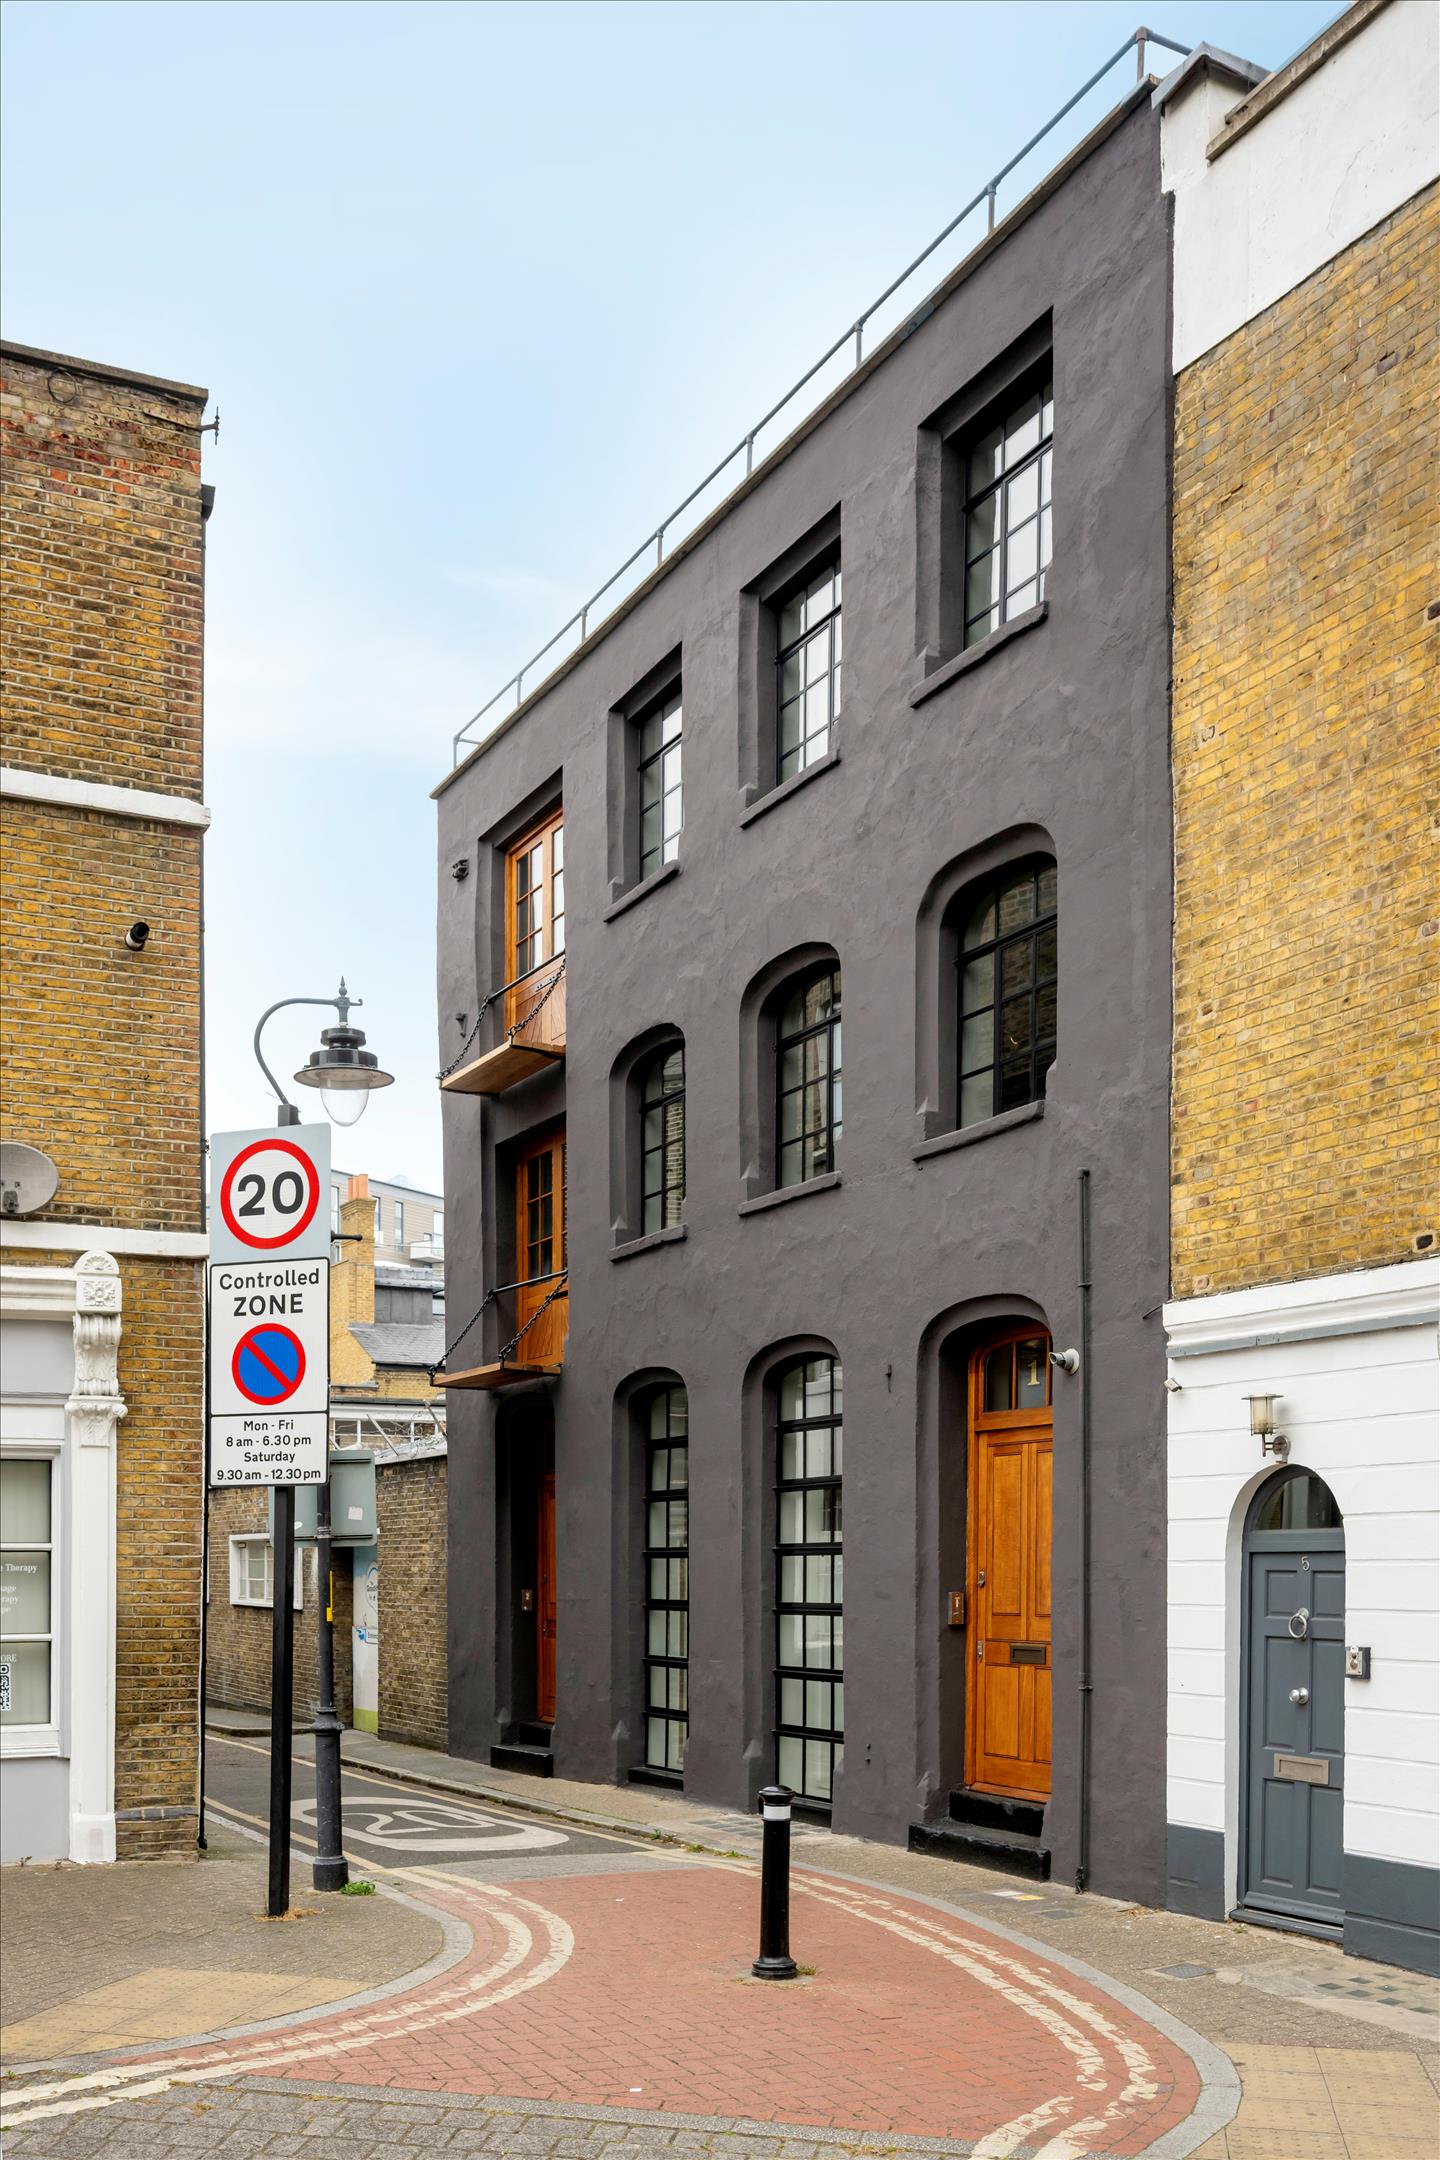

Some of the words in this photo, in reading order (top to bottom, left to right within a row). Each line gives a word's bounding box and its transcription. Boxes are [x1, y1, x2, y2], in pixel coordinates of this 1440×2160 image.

[238, 1171, 304, 1216] 20
[219, 1268, 320, 1290] Controlled
[233, 1293, 304, 1317] ZONE
[1027, 1359, 1040, 1387] 1
[243, 1420, 269, 1431] Mon
[278, 1419, 294, 1430] Fri
[226, 1436, 233, 1447] 8
[236, 1438, 253, 1447] am
[262, 1434, 291, 1446] 6.30
[293, 1436, 312, 1447] pm
[243, 1451, 296, 1463] Saturday
[217, 1469, 243, 1480] 9.30
[244, 1471, 261, 1480] am
[271, 1468, 302, 1480] 12.30
[303, 1470, 321, 1480] pm
[5, 1563, 38, 1574] Therapy
[1301, 1555, 1310, 1571] 5
[341, 1810, 497, 1835] 20
